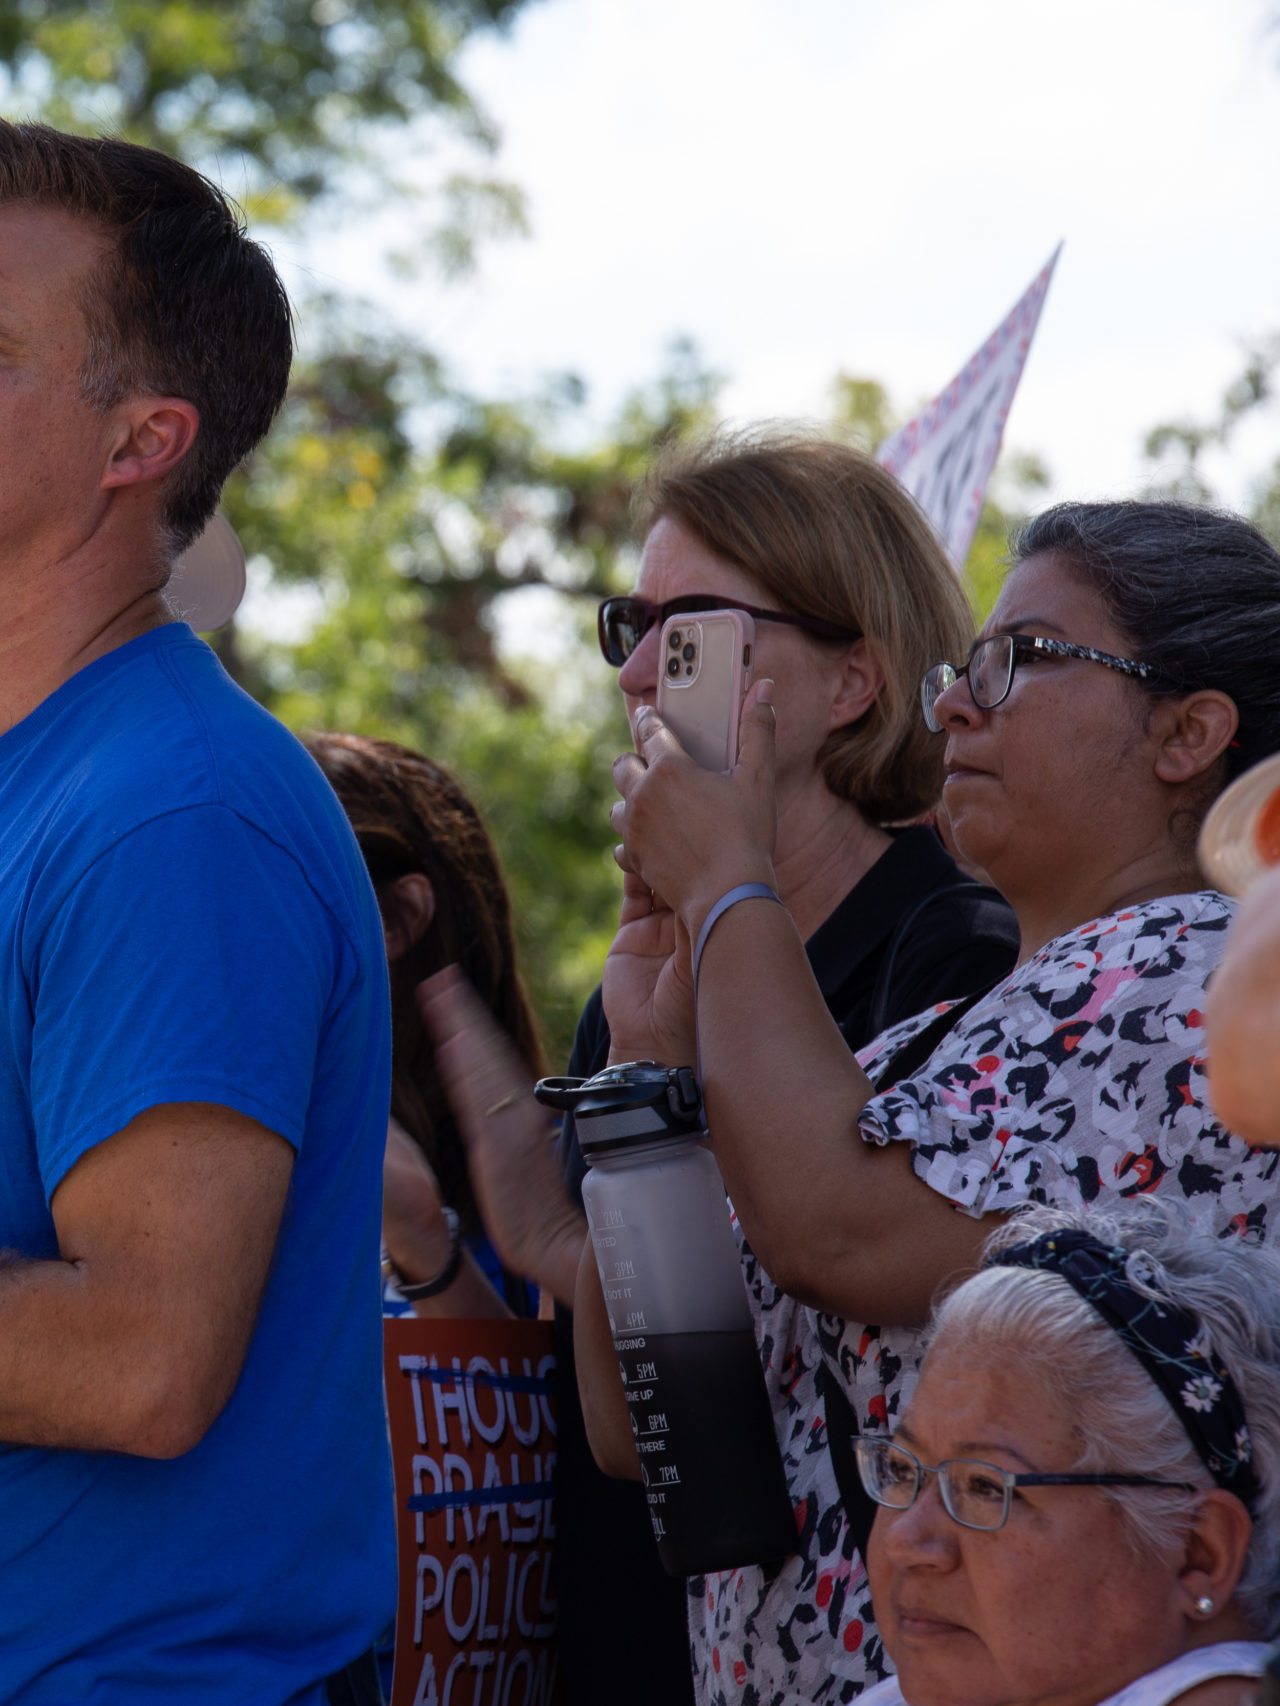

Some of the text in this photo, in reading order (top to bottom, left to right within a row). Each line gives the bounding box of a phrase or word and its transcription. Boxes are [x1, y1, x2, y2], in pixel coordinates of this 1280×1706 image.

[626, 1311, 646, 1329] 4PM
[636, 1361, 657, 1379] 5PM
[640, 1389, 654, 1401] UP
[647, 1412, 668, 1431] 6PM
[659, 1464, 679, 1482] 7PM
